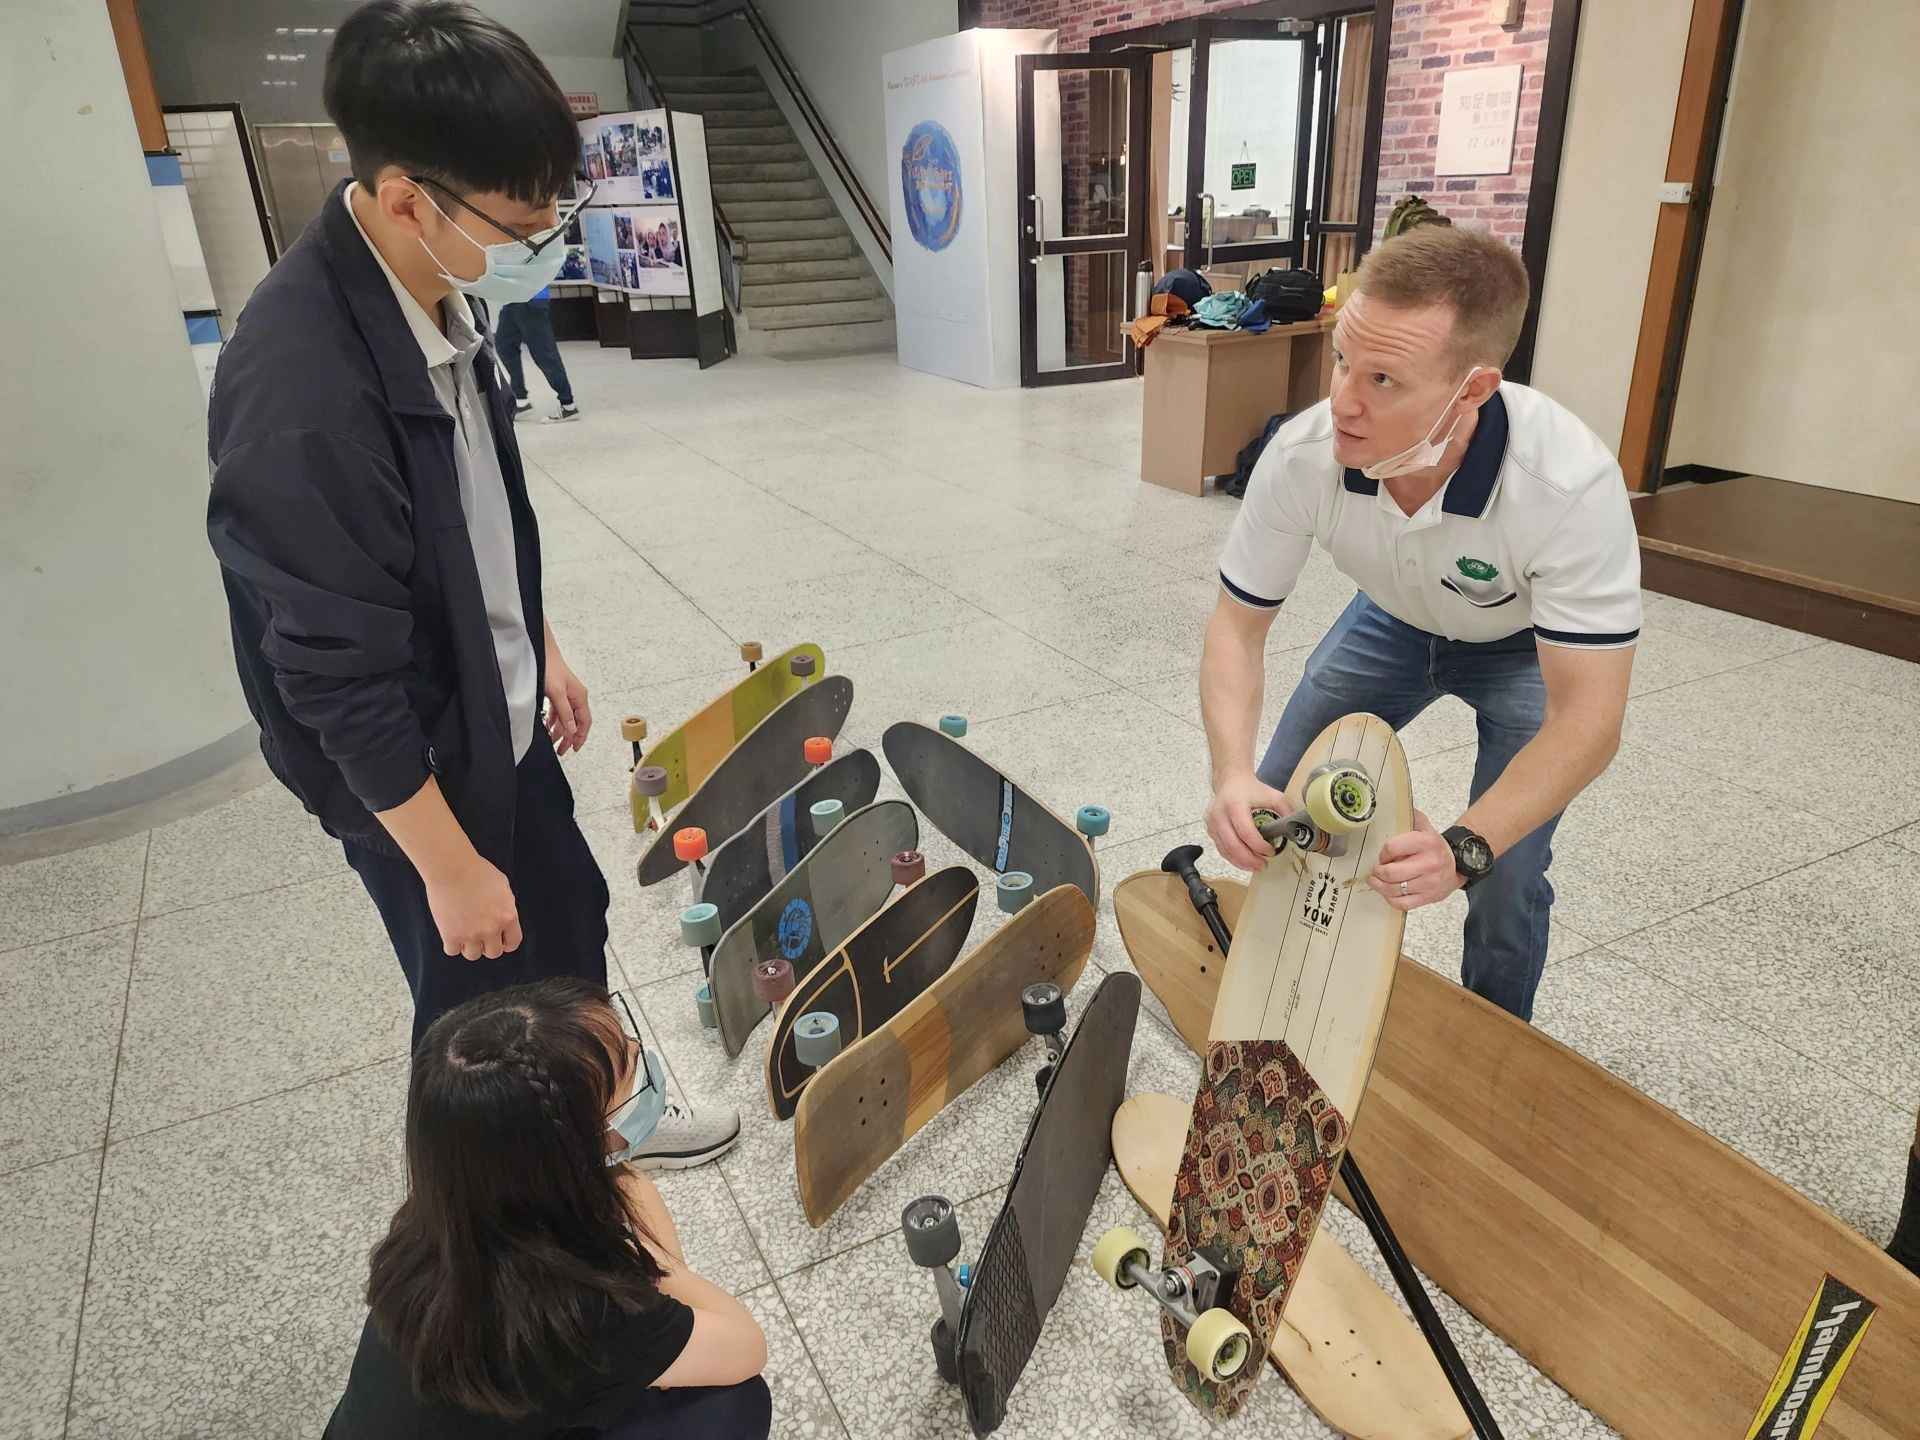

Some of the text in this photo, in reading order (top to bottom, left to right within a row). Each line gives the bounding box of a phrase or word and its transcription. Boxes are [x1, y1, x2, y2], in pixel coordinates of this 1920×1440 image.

[1232, 169, 1256, 185] OPEN
[1304, 879, 1317, 904] YOUR
[1328, 887, 1339, 914] WAVE
[1303, 904, 1333, 927] YOW
